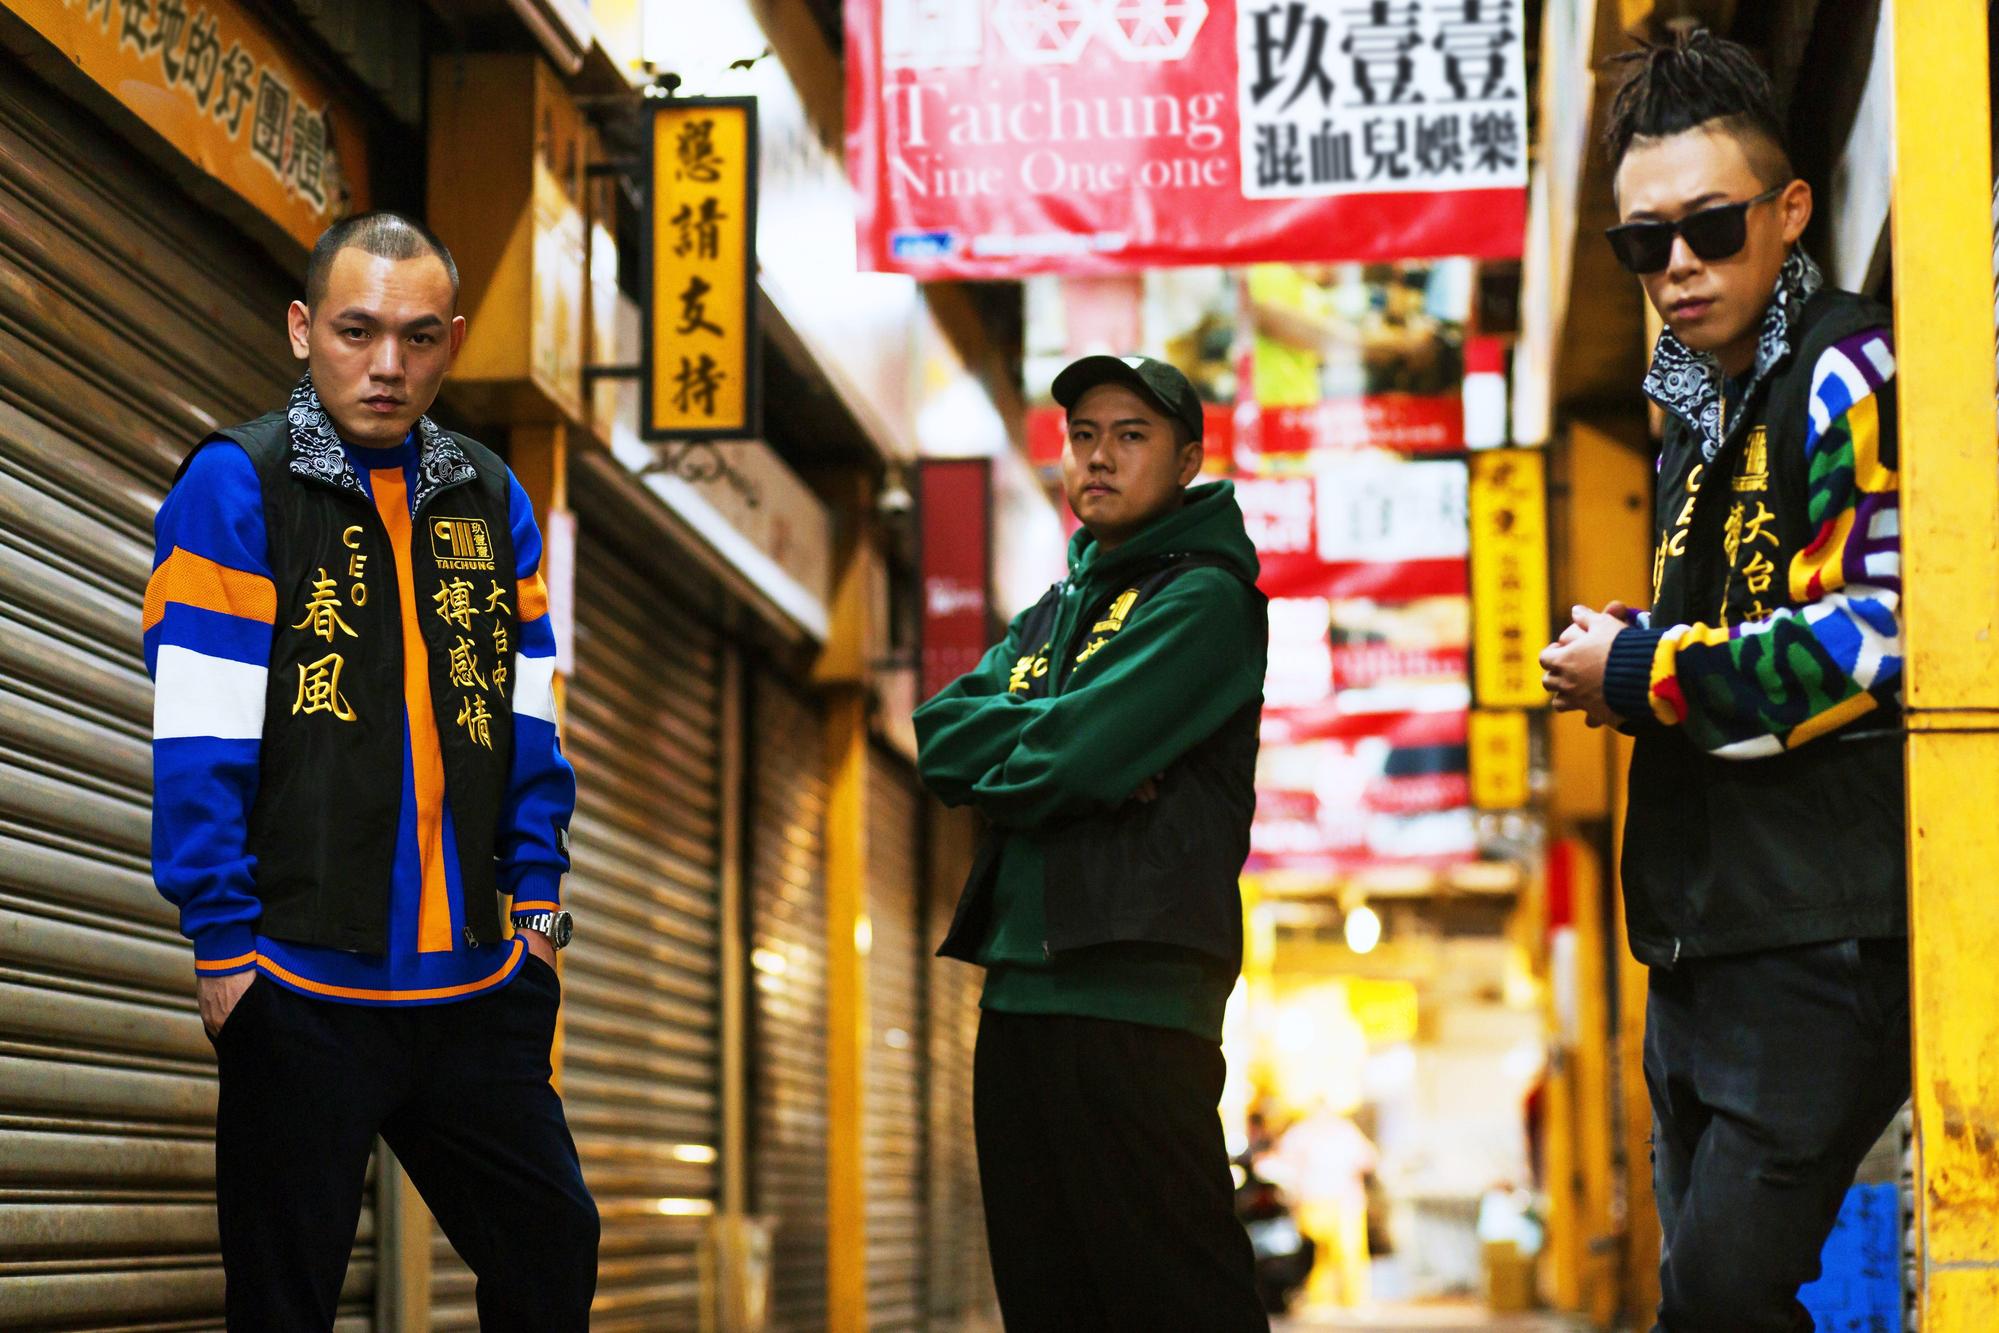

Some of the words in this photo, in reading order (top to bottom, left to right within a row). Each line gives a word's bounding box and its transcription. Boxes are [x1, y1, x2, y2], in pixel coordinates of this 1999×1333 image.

[82, 0, 326, 214] 在地的好團體
[1250, 0, 1518, 113] 玖壹壹
[883, 77, 1224, 150] Taichung
[1255, 110, 1519, 187] 混血兒娛樂
[891, 153, 1003, 199] Nine
[1020, 149, 1124, 193] One
[1139, 156, 1228, 189] one
[670, 118, 728, 417] 懇請支持
[342, 525, 368, 607] CEO
[435, 559, 496, 571] TAICHUNG
[291, 567, 359, 722] 春風
[431, 576, 493, 751] 搏感情
[485, 579, 511, 698] 大台中
